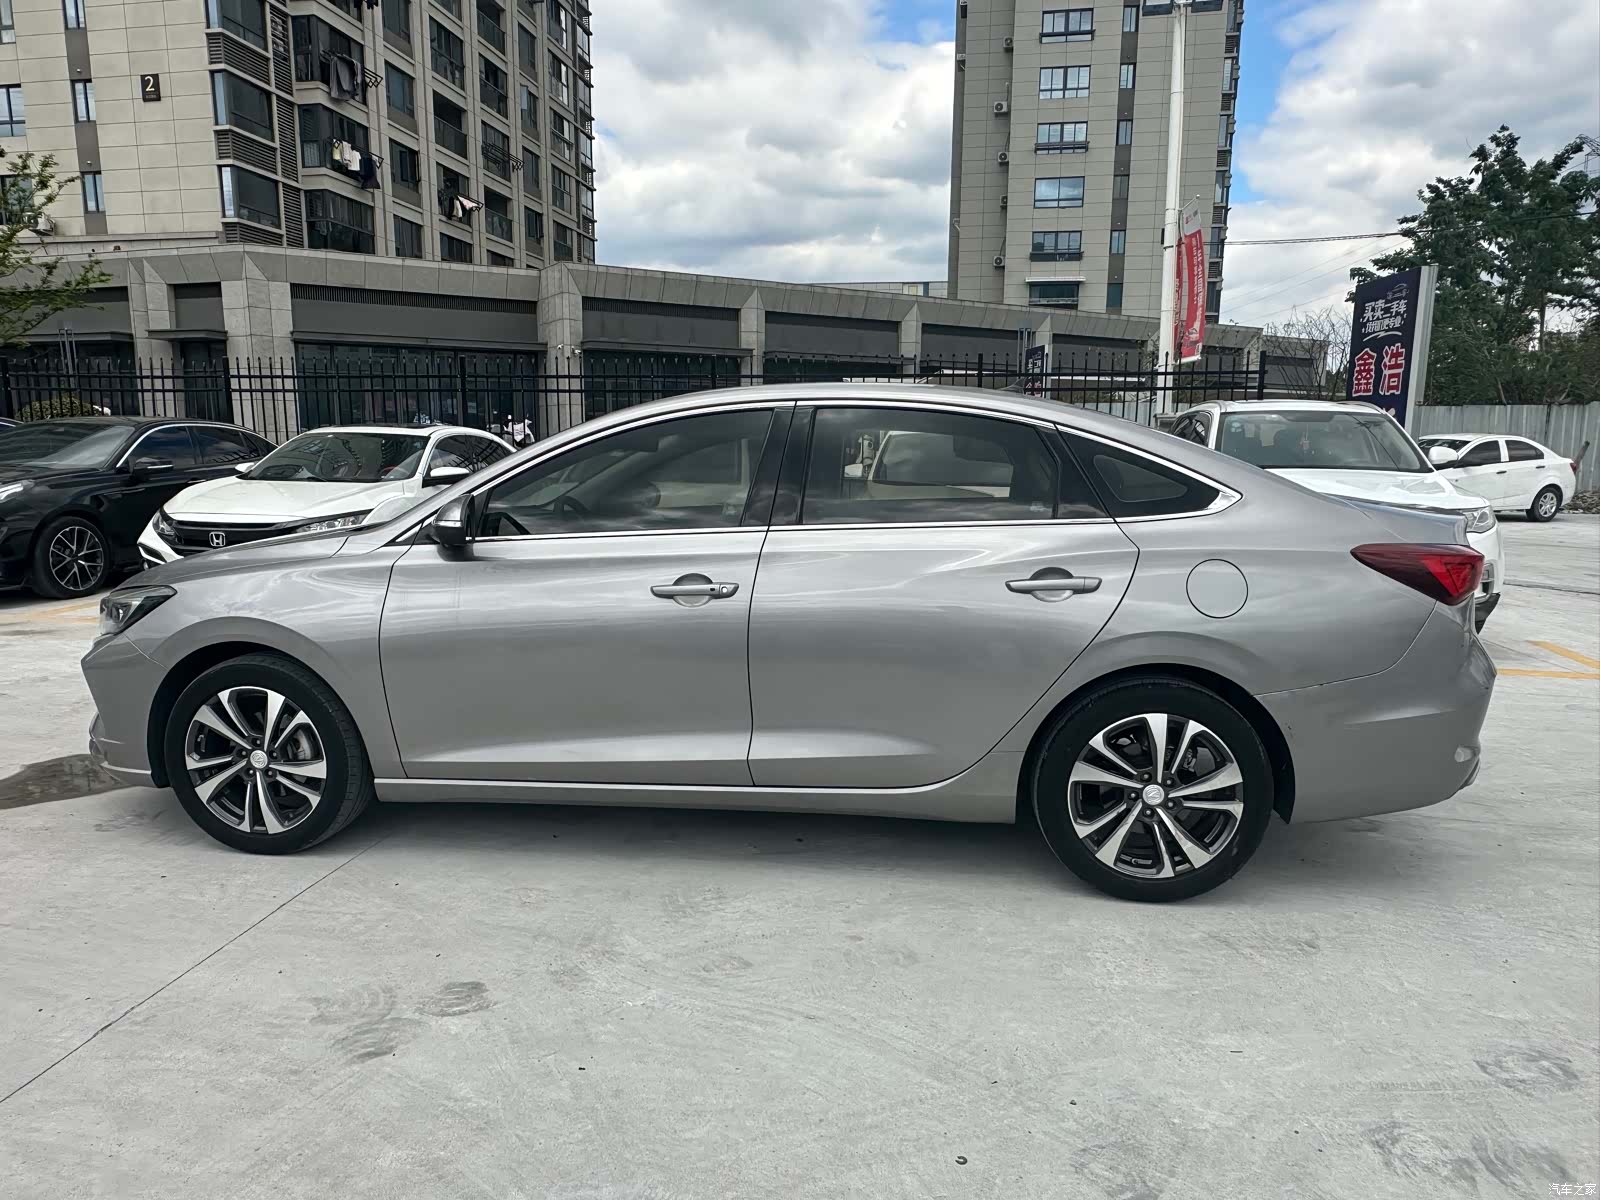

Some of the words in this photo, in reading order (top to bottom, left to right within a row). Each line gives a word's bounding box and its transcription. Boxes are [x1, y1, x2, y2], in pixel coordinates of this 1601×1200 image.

[144, 75, 155, 91] 2
[1363, 299, 1407, 322] 买卖二手车
